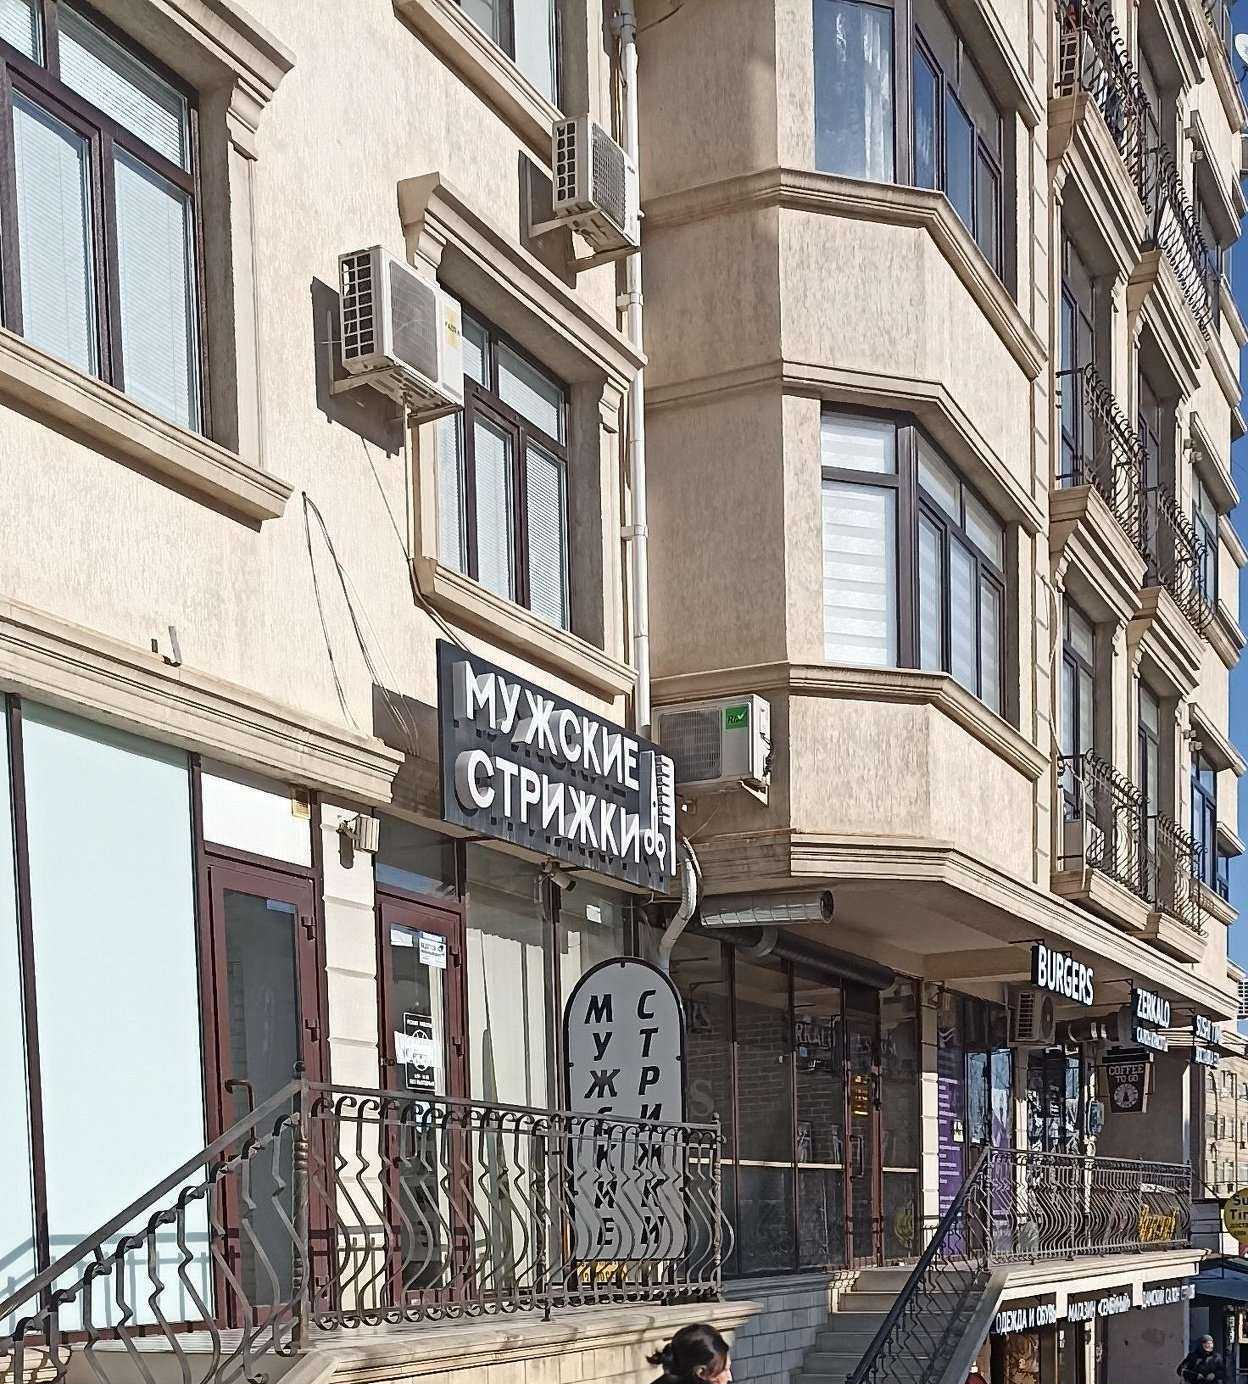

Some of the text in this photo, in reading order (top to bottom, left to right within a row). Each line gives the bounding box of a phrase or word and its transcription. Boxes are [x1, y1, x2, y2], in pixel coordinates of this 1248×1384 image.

[460, 660, 640, 791] МУЖСКИЕ
[462, 749, 640, 864] СТРИЖКИ
[1037, 944, 1094, 1006] BURGERS
[1136, 988, 1171, 1029] ZERKALO
[1108, 1064, 1145, 1076] COFFEE
[1114, 1075, 1127, 1083] TO
[995, 1308, 1028, 1336] ОДЕЖДА
[1028, 1307, 1035, 1328] И
